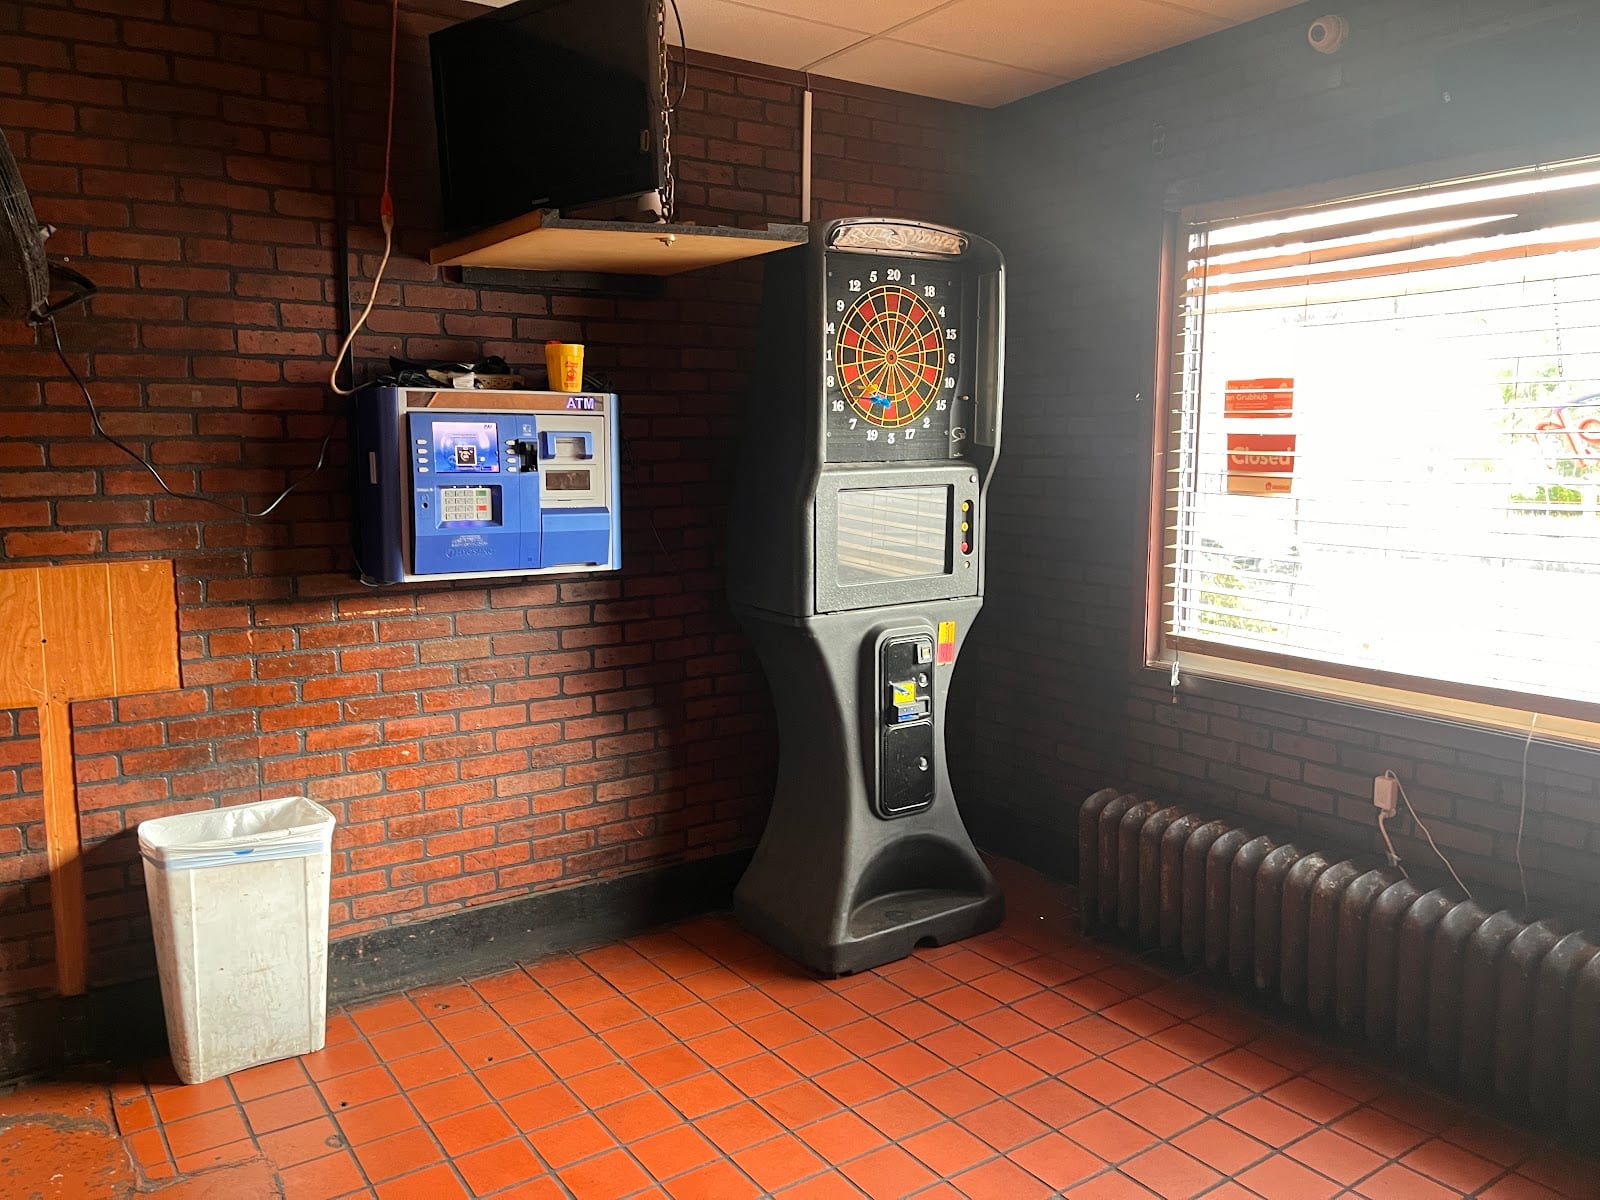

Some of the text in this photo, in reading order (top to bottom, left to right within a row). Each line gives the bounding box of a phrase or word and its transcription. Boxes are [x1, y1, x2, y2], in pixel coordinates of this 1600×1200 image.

[870, 271, 877, 282] 5
[887, 269, 901, 280] 20
[911, 275, 915, 285] 1
[849, 280, 861, 291] 12
[925, 286, 935, 296] 18
[837, 301, 844, 311] 9
[938, 306, 945, 317] 4
[946, 329, 956, 339] 13
[949, 353, 955, 364] 6
[827, 377, 834, 387] 8
[945, 377, 954, 388] 10
[566, 397, 595, 409] ATM
[832, 401, 844, 411] 16
[936, 400, 946, 410] 15
[849, 419, 857, 429] 7
[923, 418, 930, 428] 2
[867, 429, 878, 440] 19
[888, 433, 895, 444] 3
[905, 429, 915, 439] 17
[1231, 446, 1292, 466] Closed
